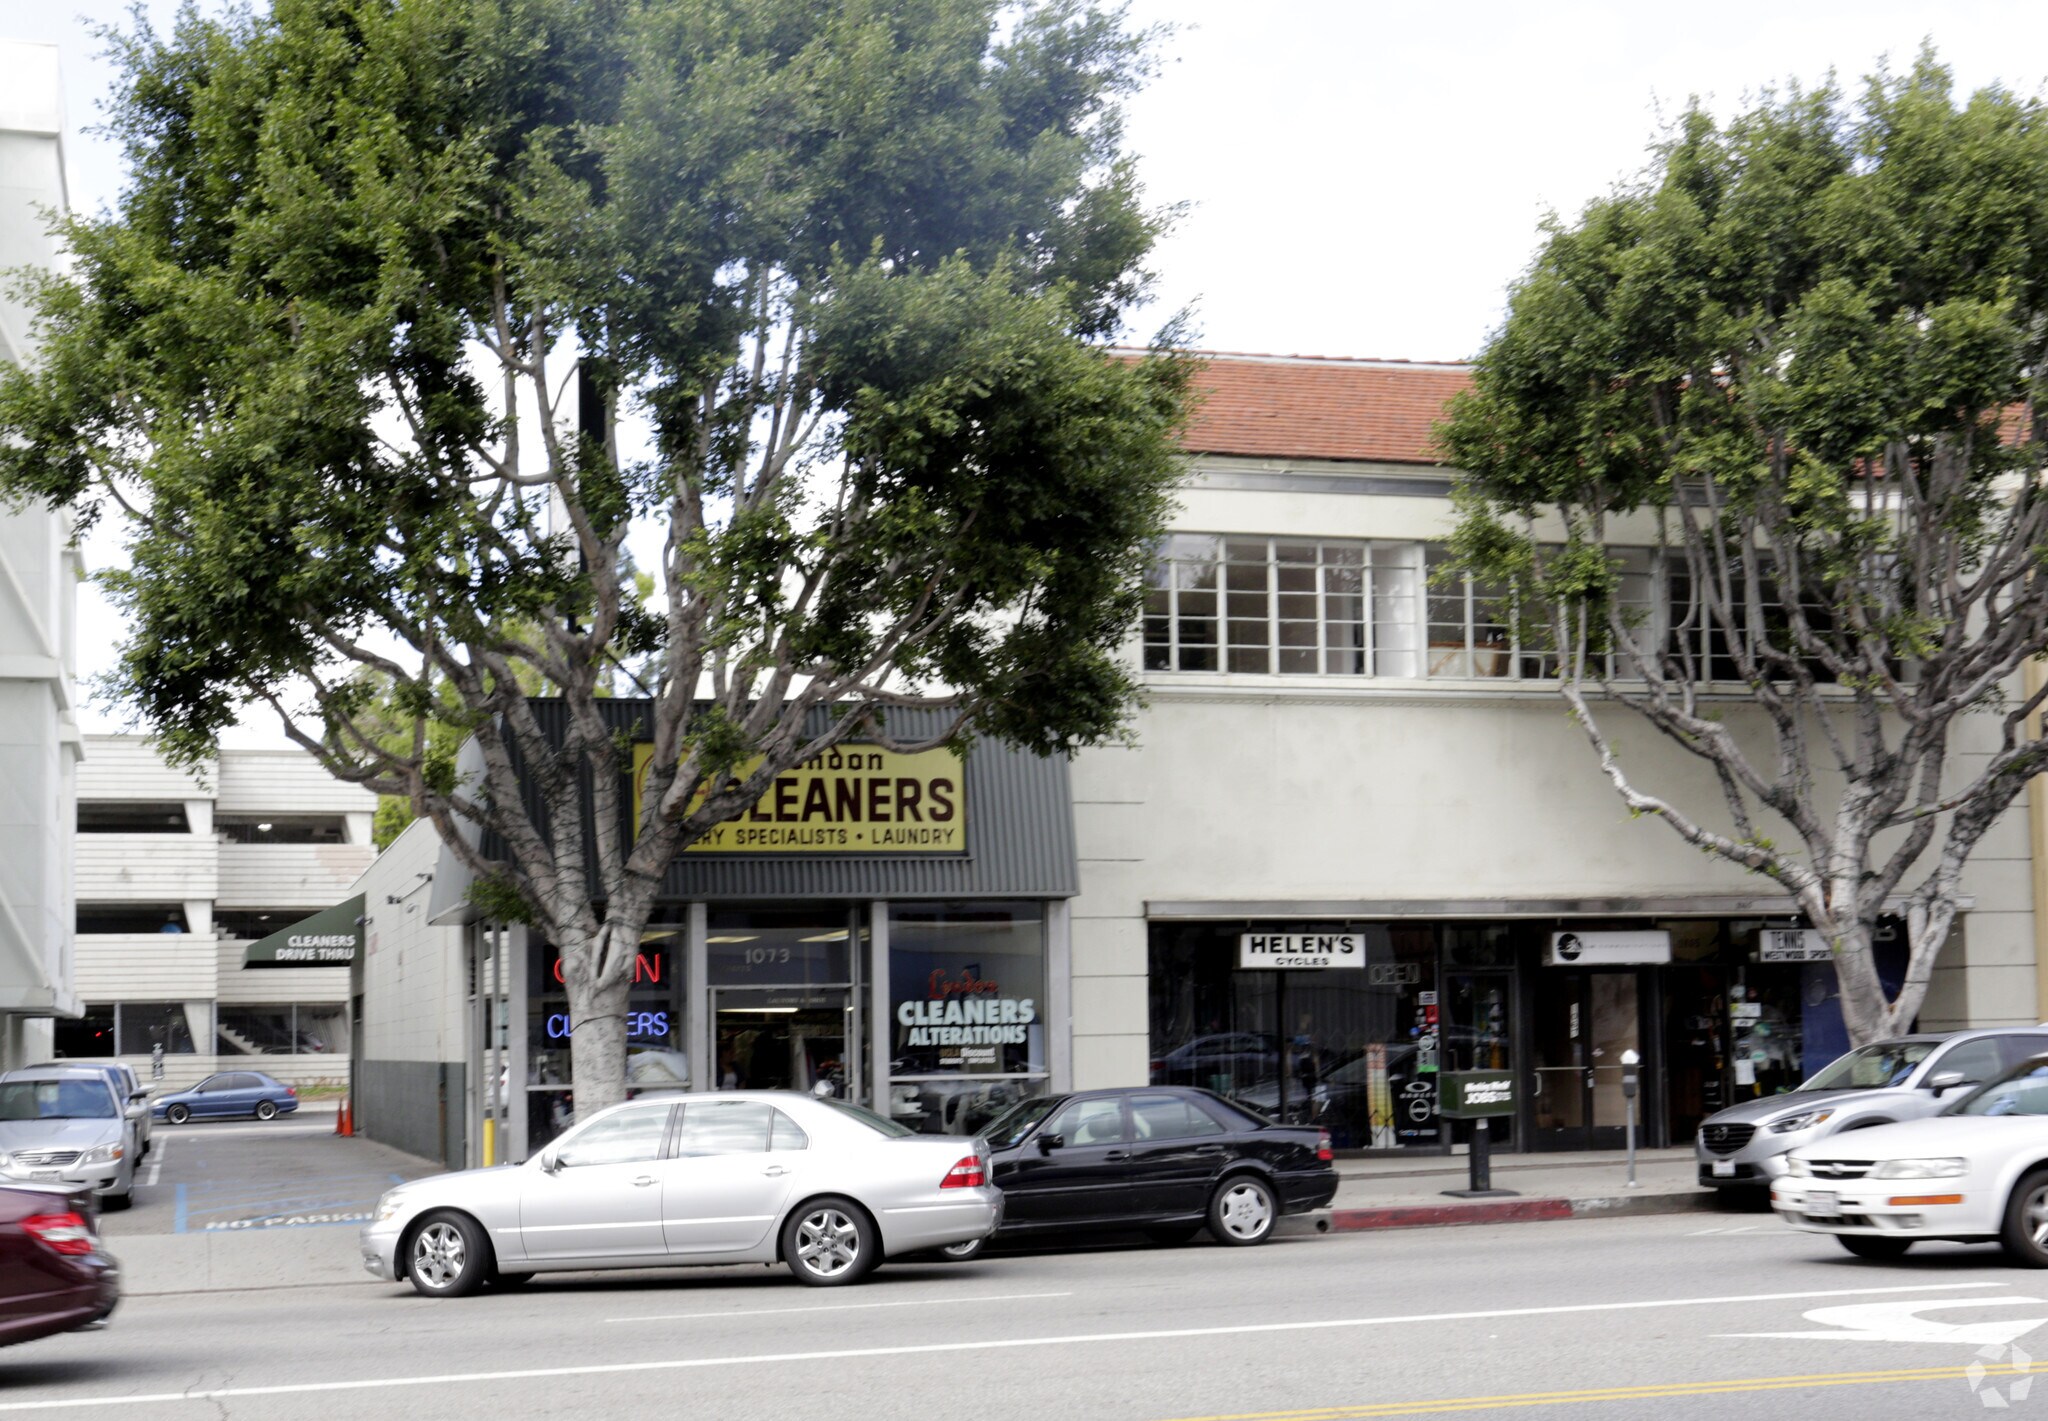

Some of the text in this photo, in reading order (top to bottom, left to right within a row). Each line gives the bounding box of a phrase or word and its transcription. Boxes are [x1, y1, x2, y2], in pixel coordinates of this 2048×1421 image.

[736, 829, 847, 845] SPECIALISTS
[872, 828, 955, 845] LAUNDRY
[287, 934, 357, 948] CLEANERS
[1250, 936, 1355, 954] HELEN'S
[1769, 931, 1805, 949] TENNIS
[275, 948, 356, 960] DRIVE THRU
[745, 947, 791, 965] 1073
[1275, 957, 1330, 966] CYCLES
[1372, 966, 1418, 983] OPEN
[897, 998, 1036, 1027] CLEANERS
[907, 1025, 1027, 1047] ALTERATIONS
